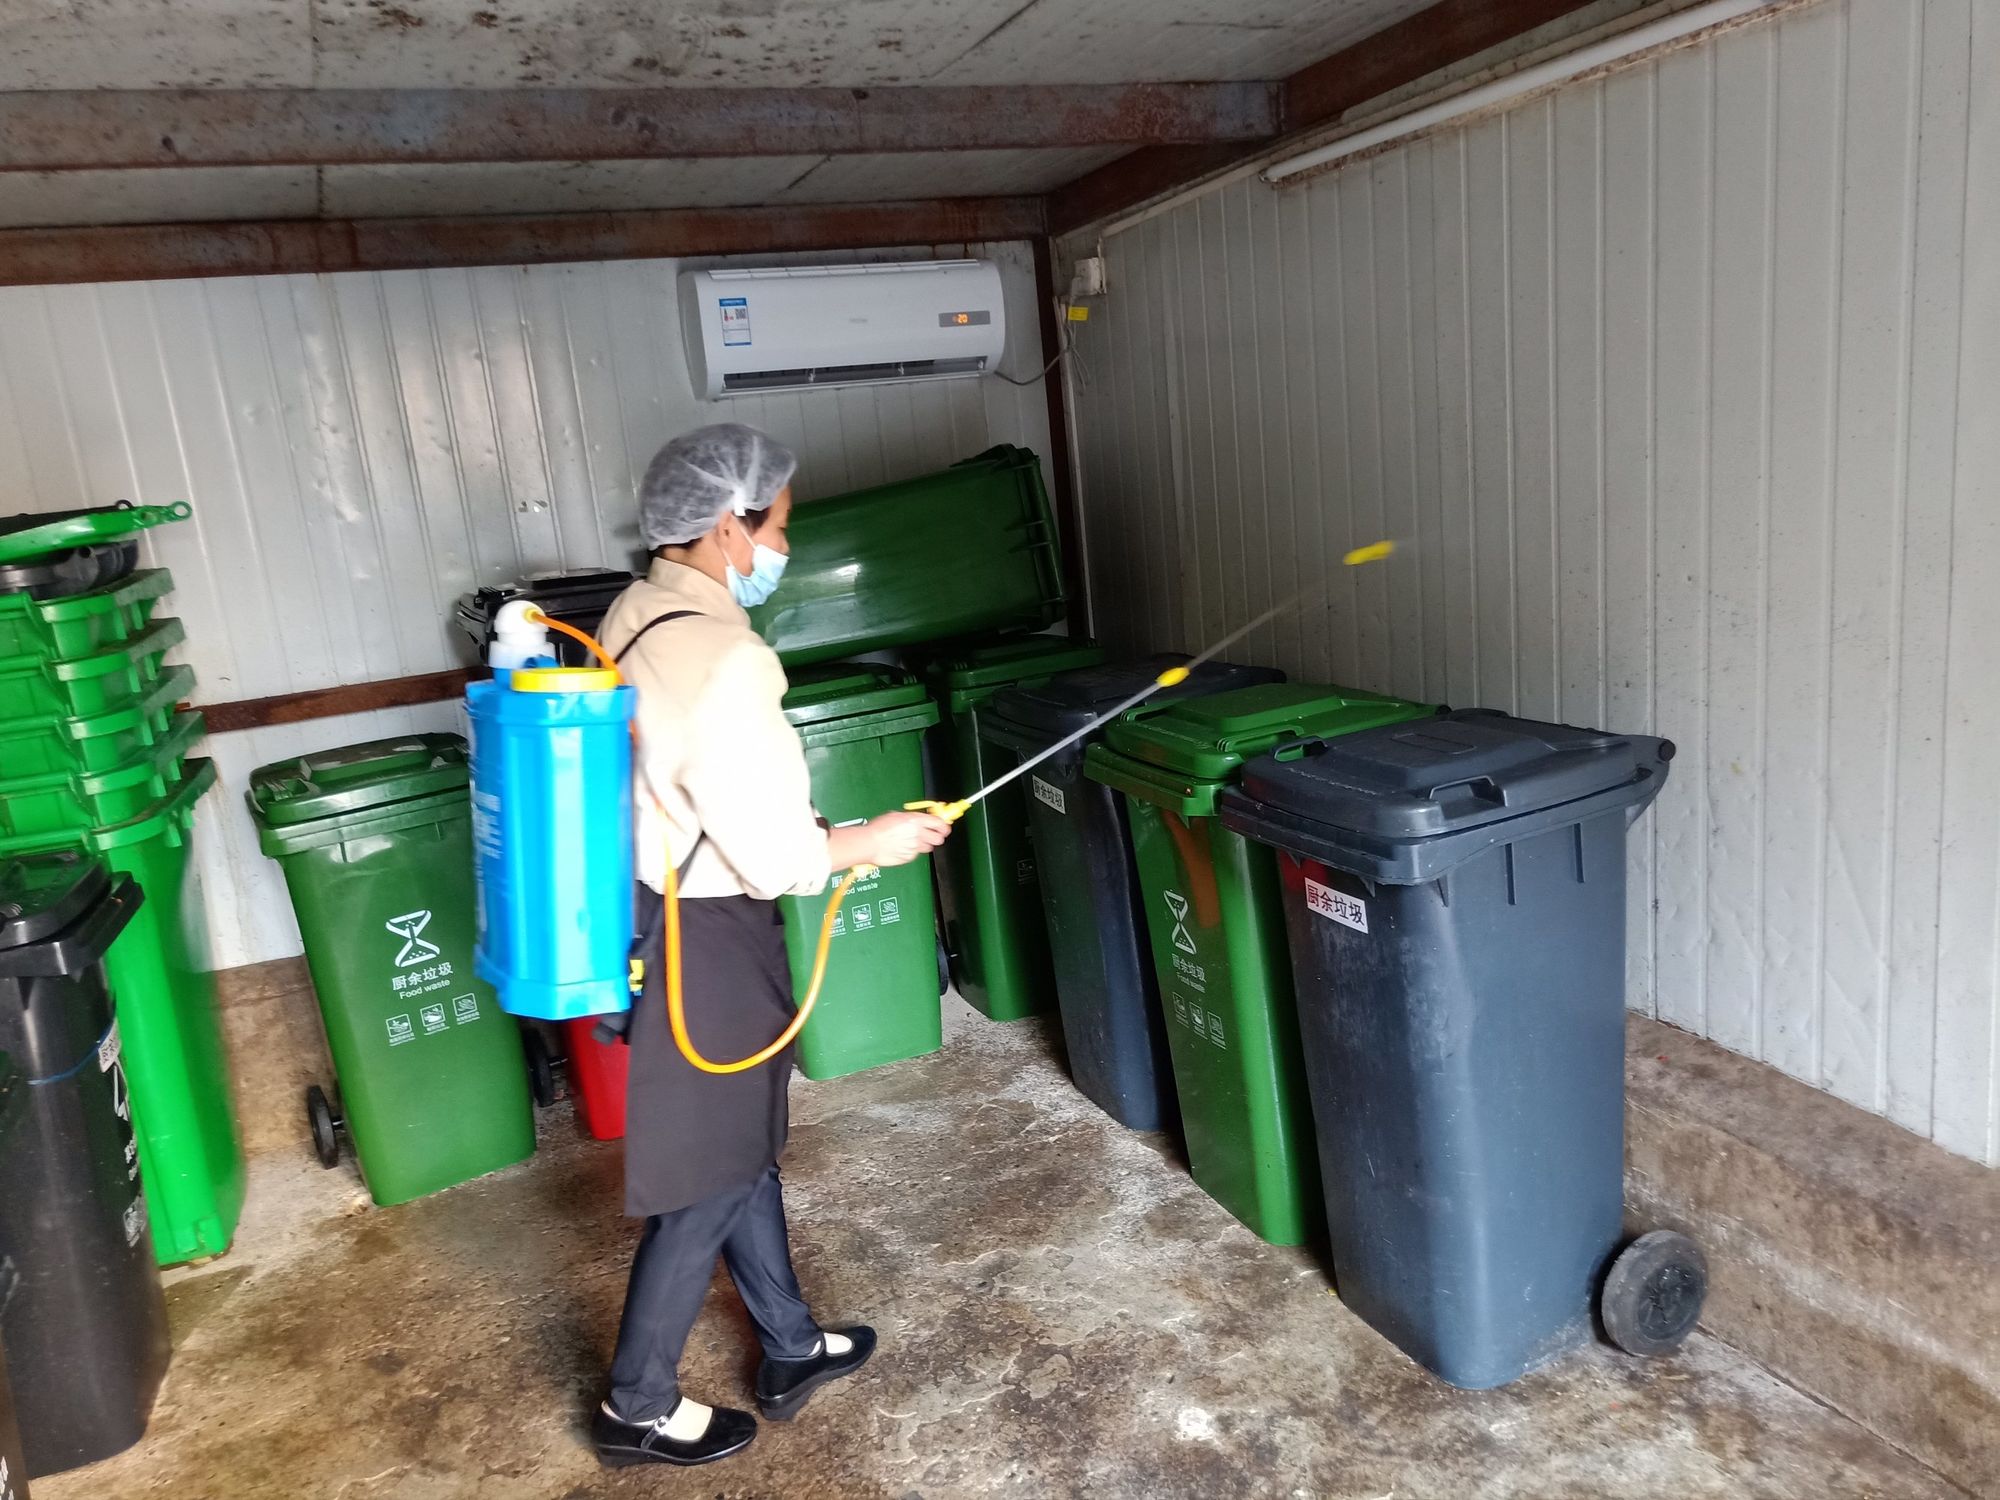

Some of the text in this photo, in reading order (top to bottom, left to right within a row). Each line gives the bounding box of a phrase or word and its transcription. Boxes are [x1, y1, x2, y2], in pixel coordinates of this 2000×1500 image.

[857, 882, 878, 893] waste
[1307, 884, 1365, 926] 厨余垃圾
[392, 962, 454, 991] 厨余垃圾
[399, 979, 451, 1000] Food waste
